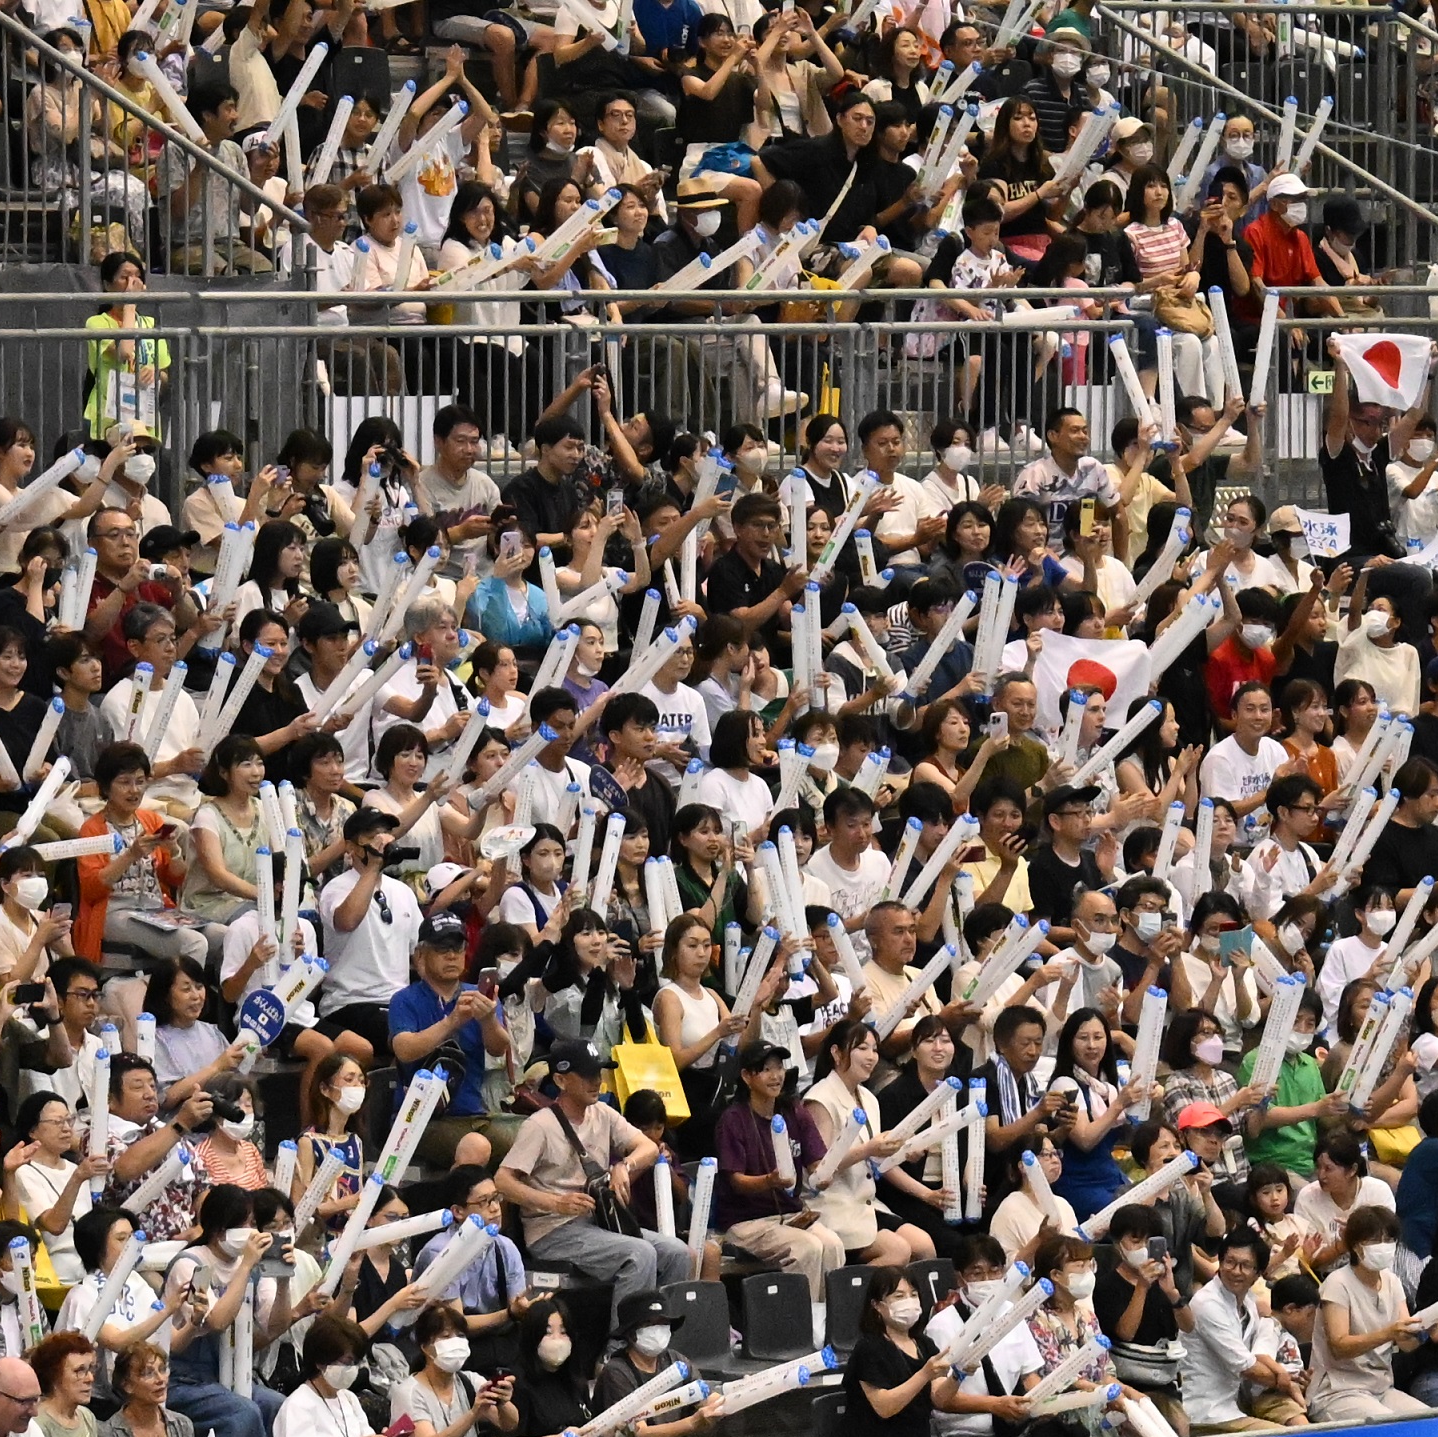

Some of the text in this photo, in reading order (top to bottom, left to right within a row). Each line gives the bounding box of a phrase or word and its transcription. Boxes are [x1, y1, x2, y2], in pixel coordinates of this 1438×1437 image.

[820, 1002, 849, 1017] PEAC
[404, 1097, 422, 1124] Nikon
[21, 1266, 31, 1293] Nikon
[654, 1395, 681, 1412] Nikon
